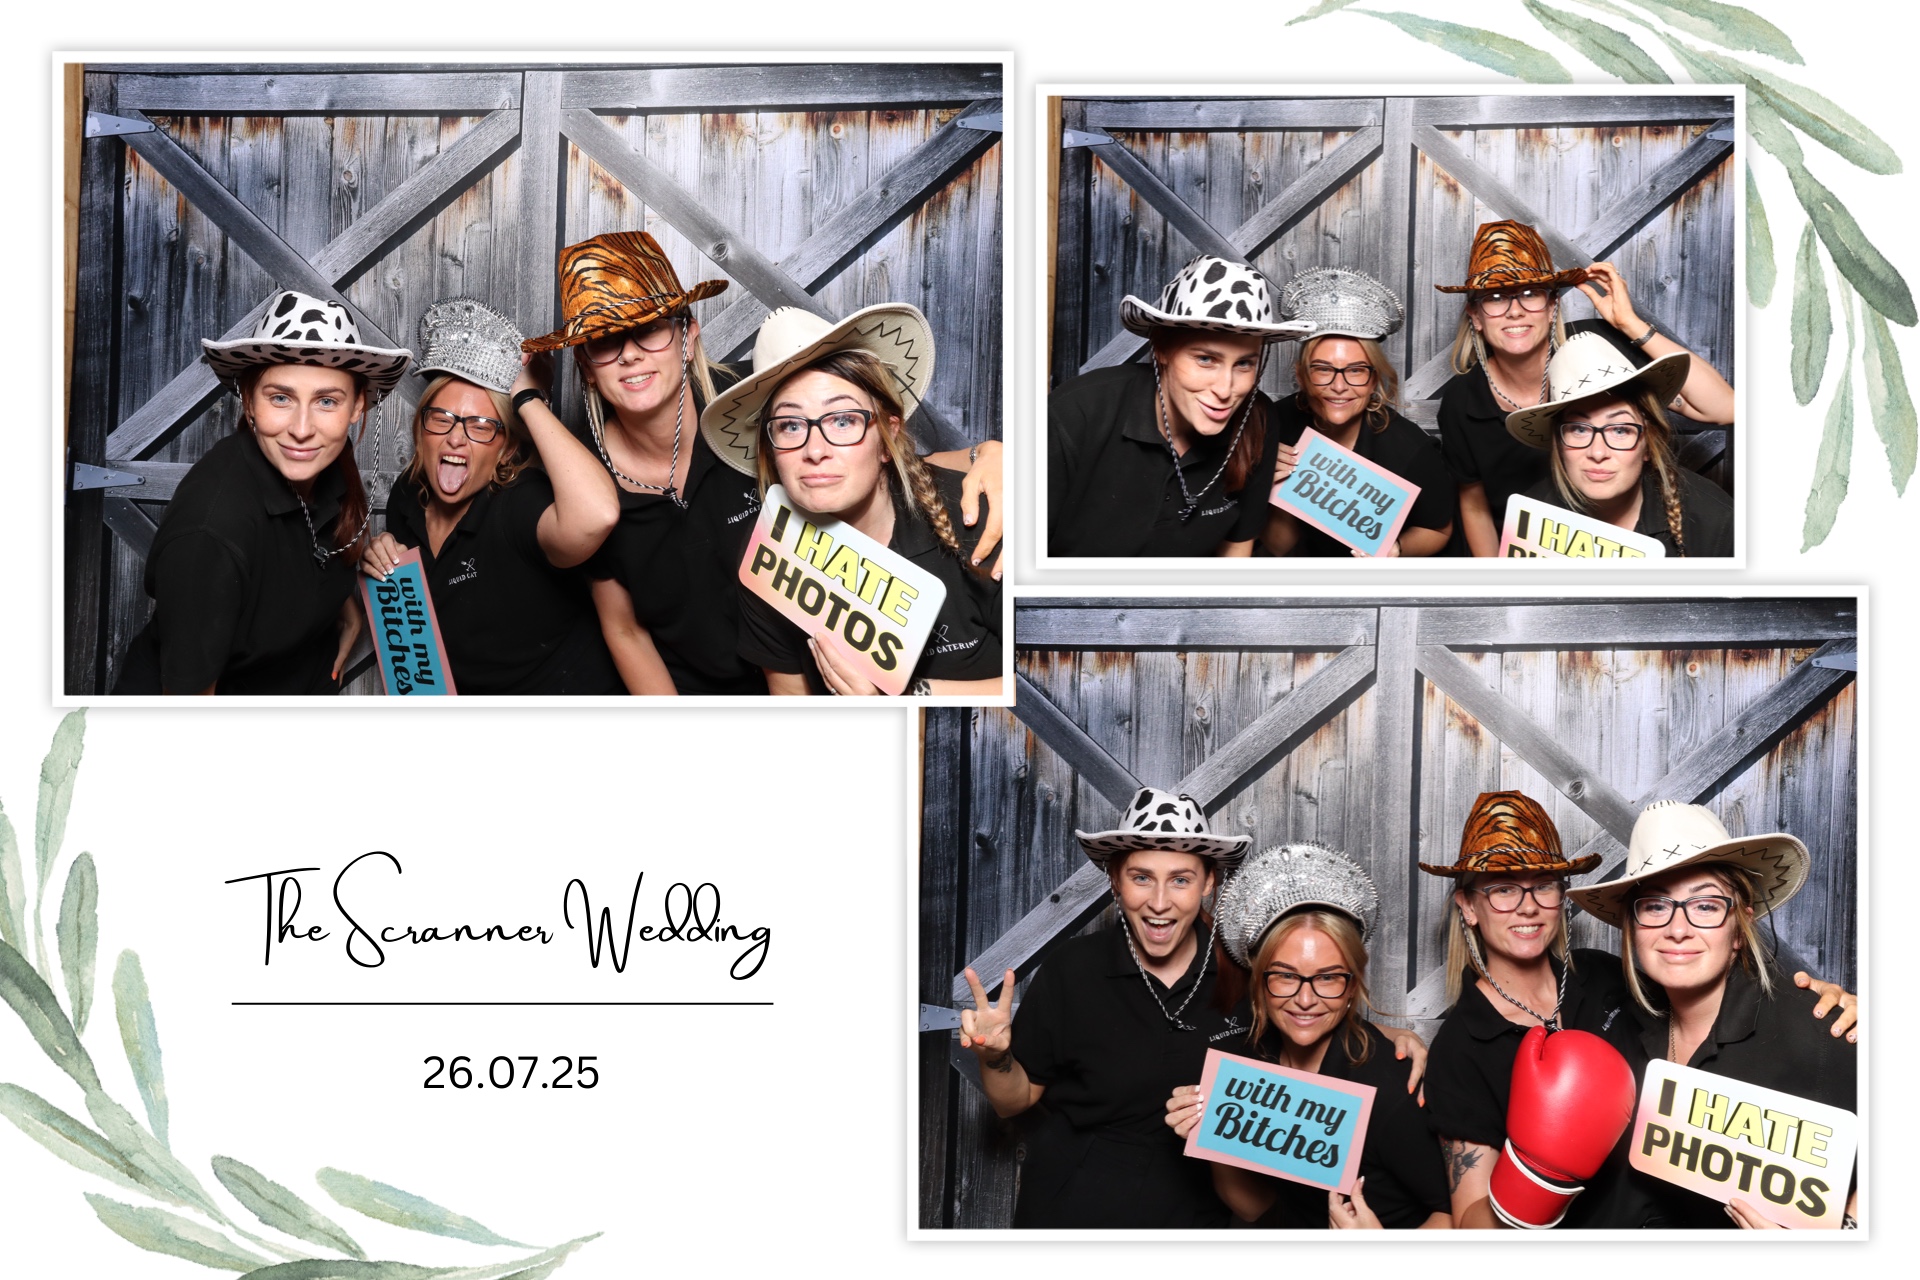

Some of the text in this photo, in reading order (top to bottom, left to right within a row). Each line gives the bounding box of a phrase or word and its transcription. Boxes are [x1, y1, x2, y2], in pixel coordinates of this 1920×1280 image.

[727, 510, 749, 524] LIQUID
[1292, 469, 1383, 540] Bitches
[1309, 453, 1396, 516] with my
[1516, 509, 1531, 540] I
[770, 504, 919, 627] I HATE
[375, 576, 414, 696] Bitches
[399, 577, 436, 686] with my
[750, 543, 904, 672] PHOTOS
[936, 637, 979, 654] CATERING
[1213, 1102, 1340, 1169] Bitches
[1224, 1077, 1347, 1137] with my
[1658, 1078, 1833, 1168] I HATE
[1641, 1122, 1830, 1218] PHOTOS
